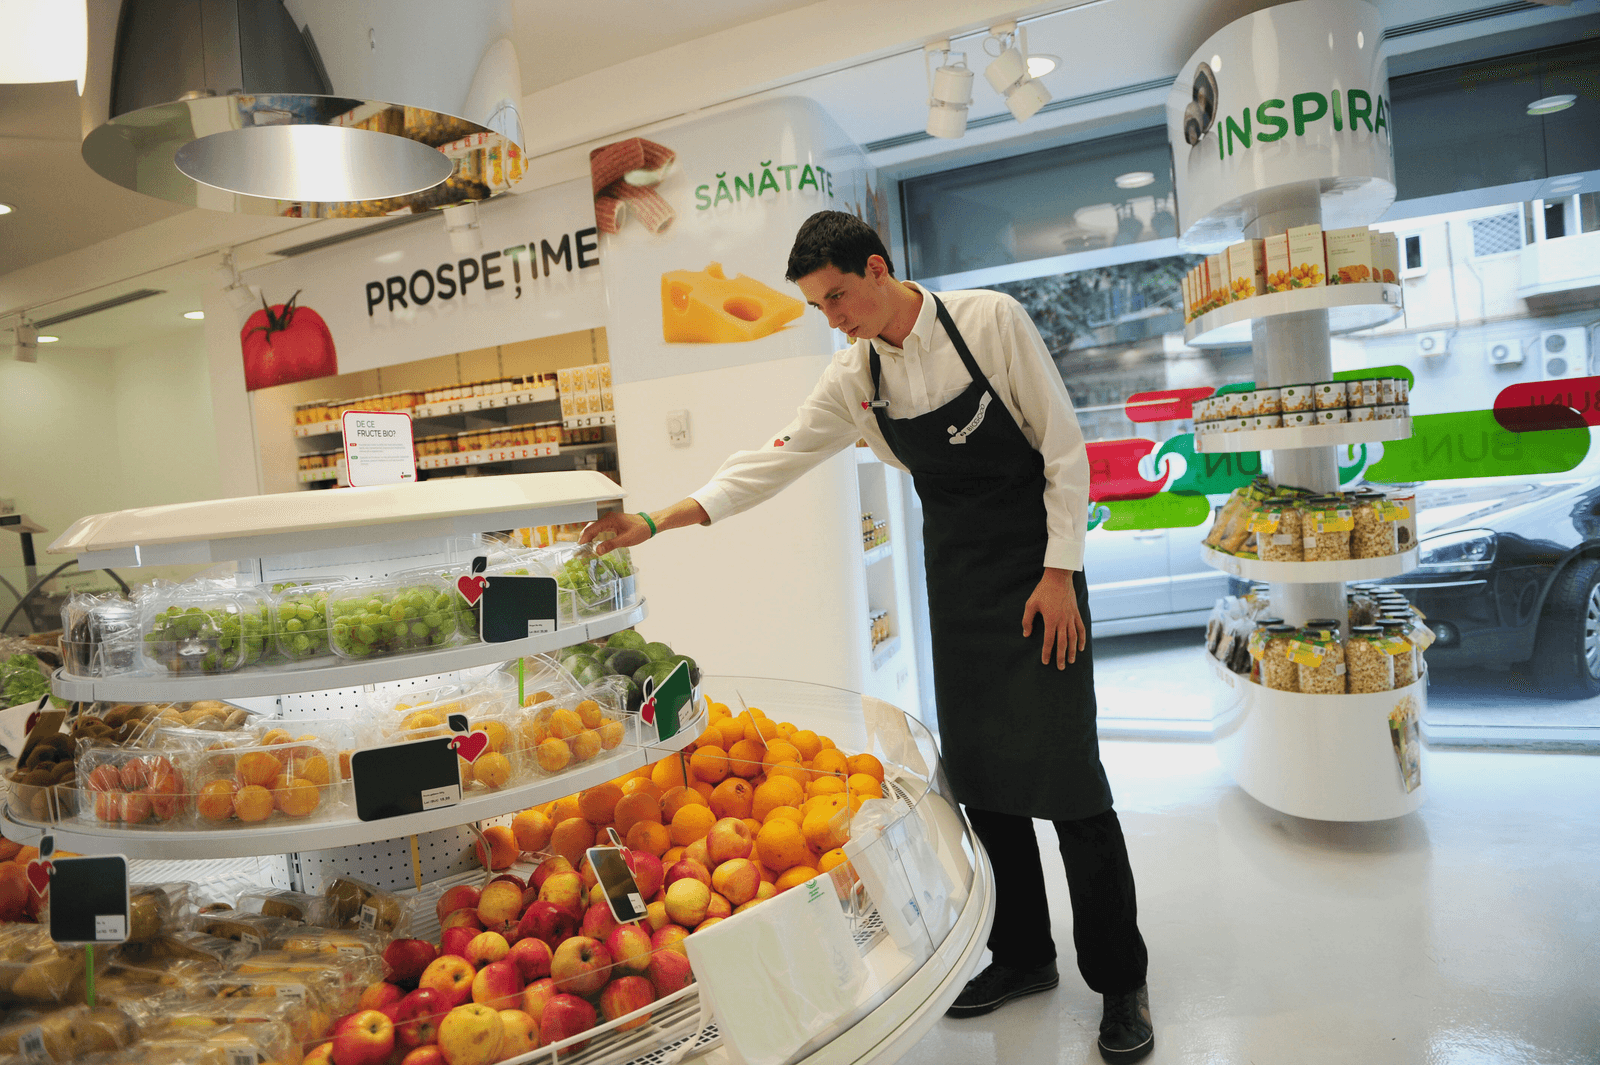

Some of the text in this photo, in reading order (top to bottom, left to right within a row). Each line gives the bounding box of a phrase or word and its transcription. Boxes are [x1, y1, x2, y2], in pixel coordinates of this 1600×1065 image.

[695, 159, 834, 211] SĂNĂTATE
[356, 420, 375, 428] DE CE
[356, 429, 396, 438] FRUCTE BIO?
